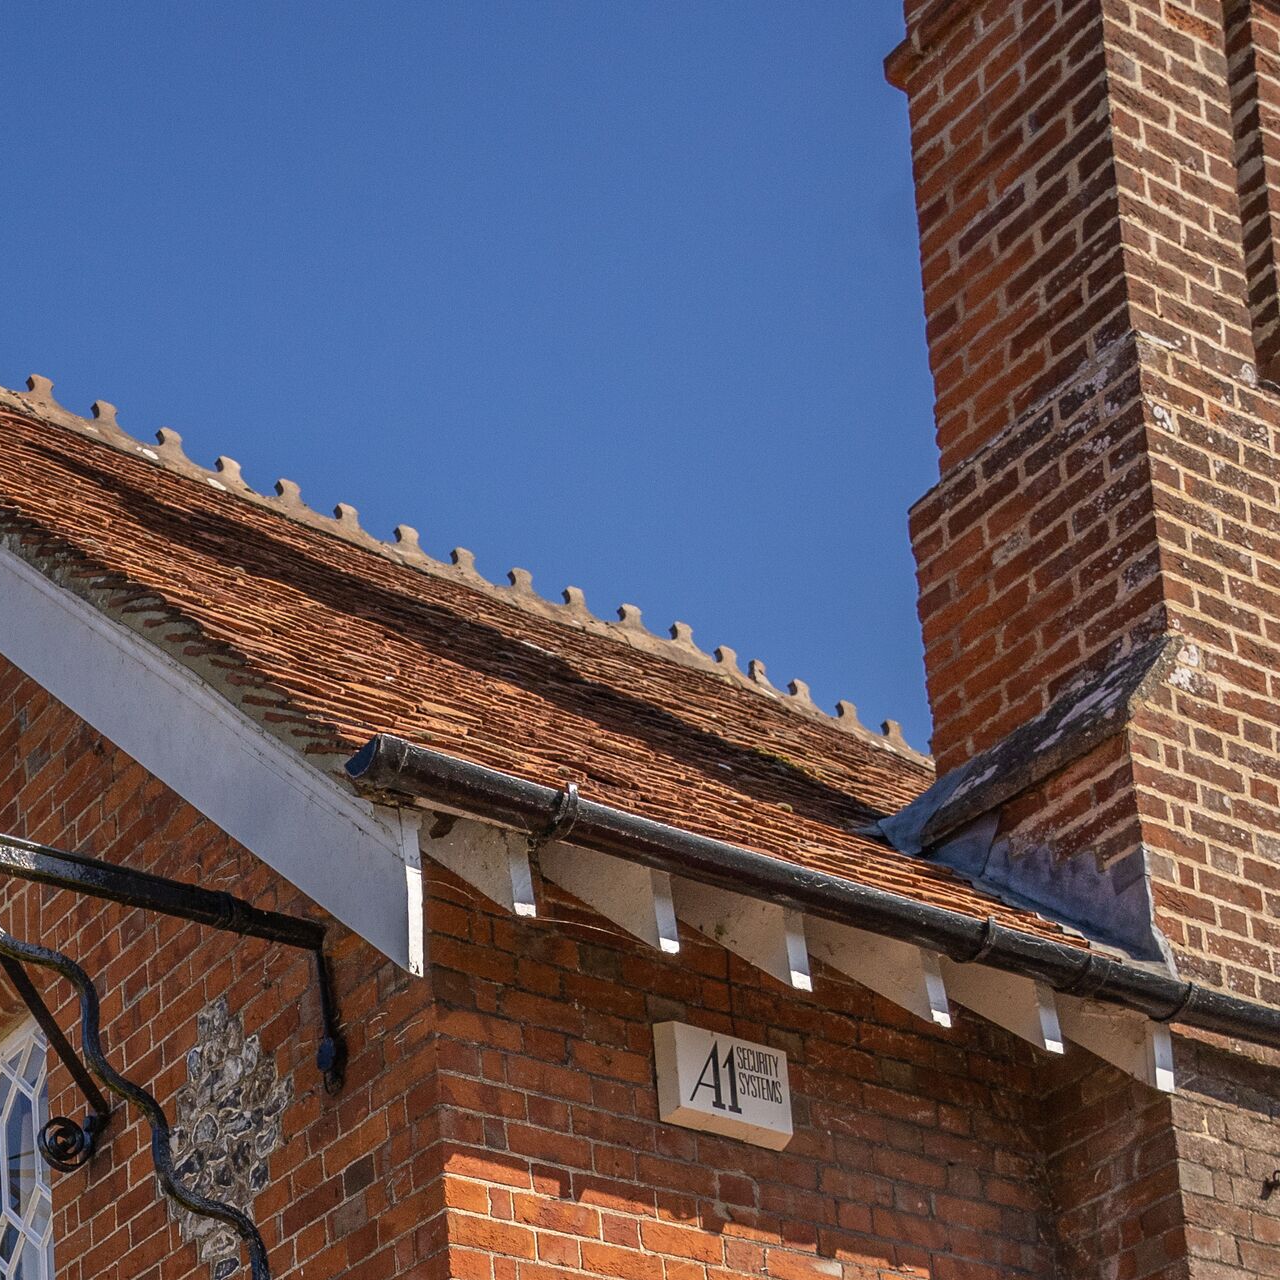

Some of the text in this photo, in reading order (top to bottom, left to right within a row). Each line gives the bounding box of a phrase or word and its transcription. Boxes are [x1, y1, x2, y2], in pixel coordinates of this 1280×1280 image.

[689, 1040, 742, 1115] A1
[736, 1046, 778, 1078] SECURITY
[738, 1071, 783, 1104] SYSTEMS
